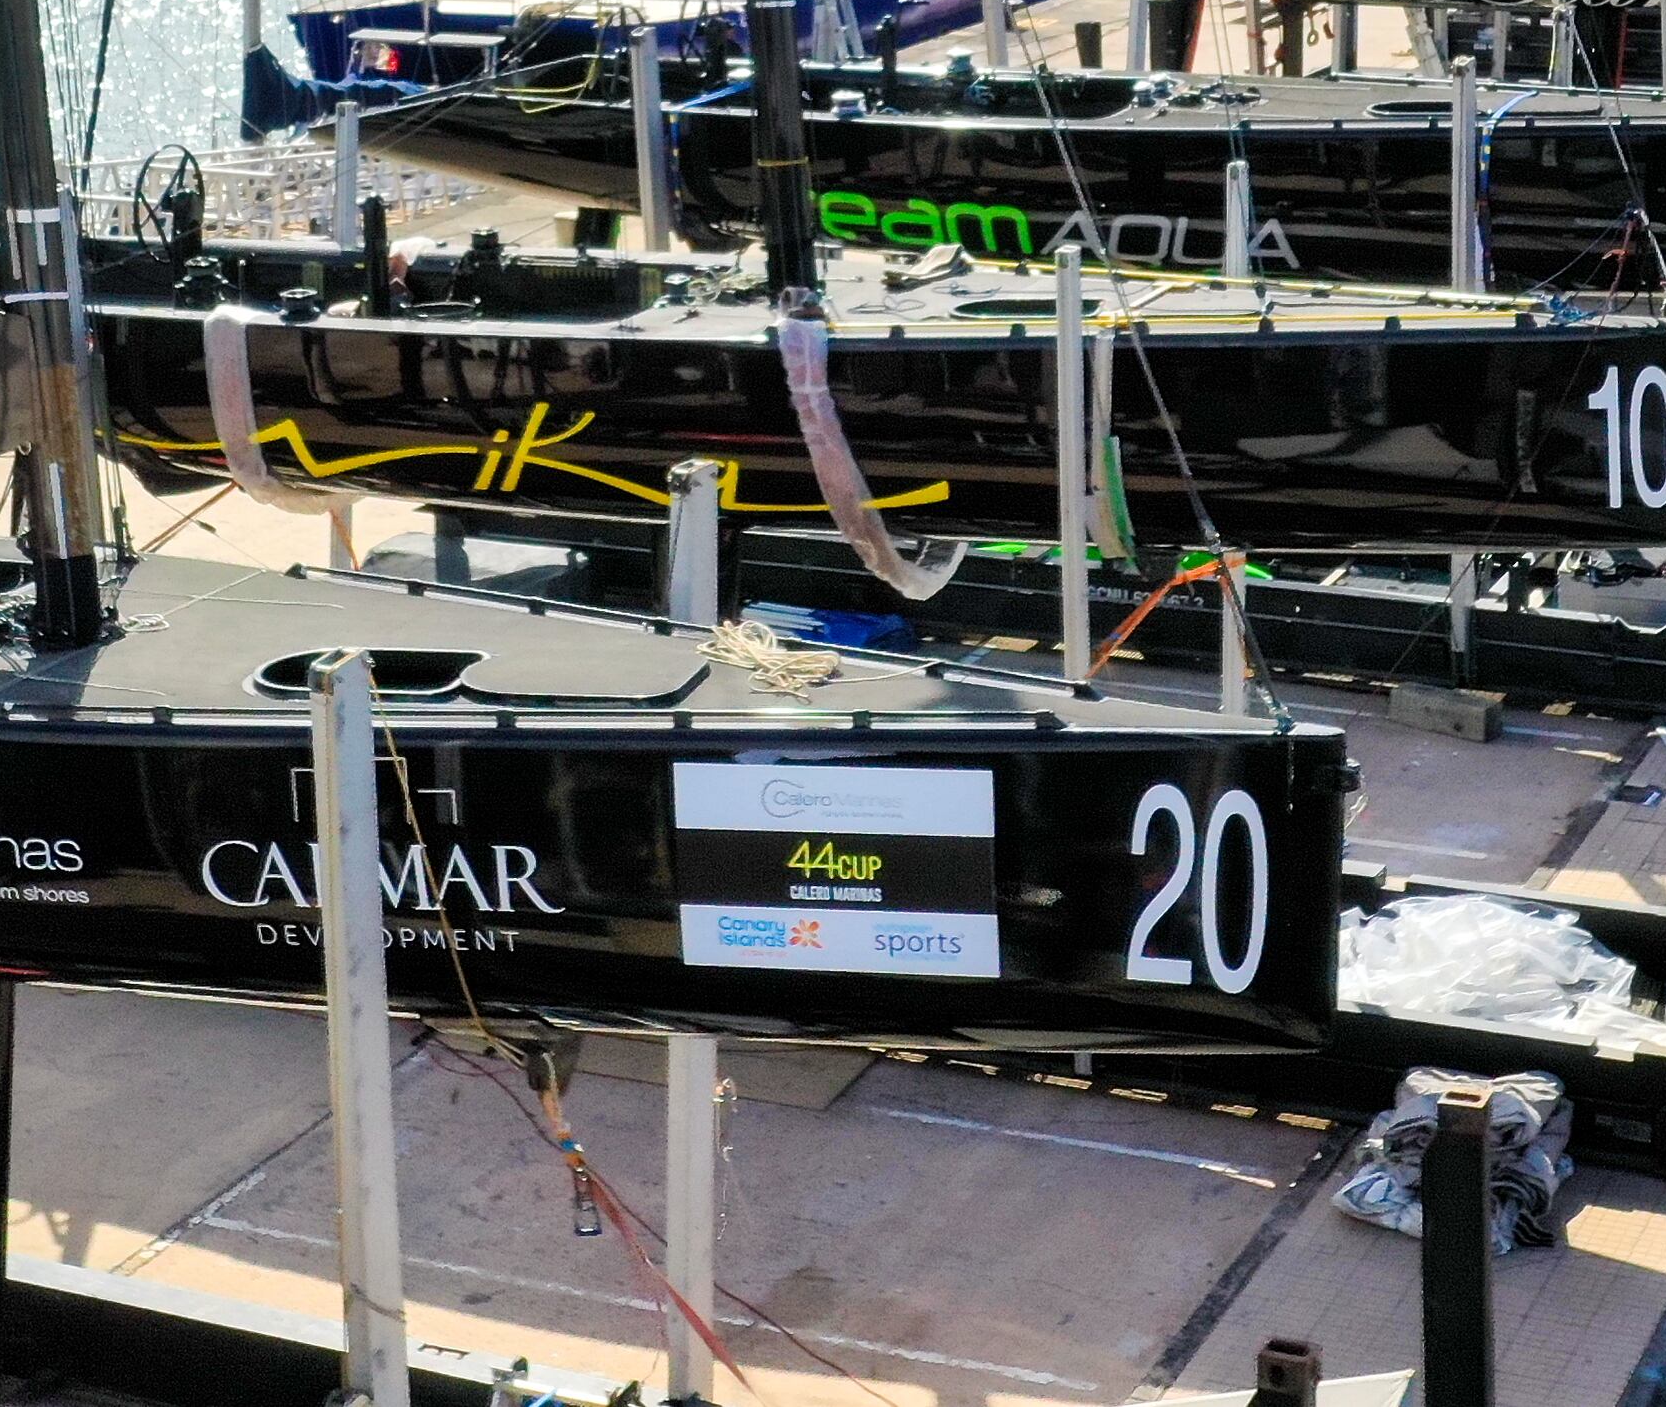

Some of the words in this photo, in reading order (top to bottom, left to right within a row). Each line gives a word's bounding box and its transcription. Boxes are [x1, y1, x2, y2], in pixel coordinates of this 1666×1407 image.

[809, 189, 1033, 255] eam
[1041, 208, 1301, 270] AQUA
[23, 886, 91, 904] shores
[790, 884, 830, 901] CALERO
[1126, 782, 1268, 994] 20
[257, 922, 520, 952] DEVPMENT
[718, 915, 786, 936] Canary
[874, 932, 962, 958] sports
